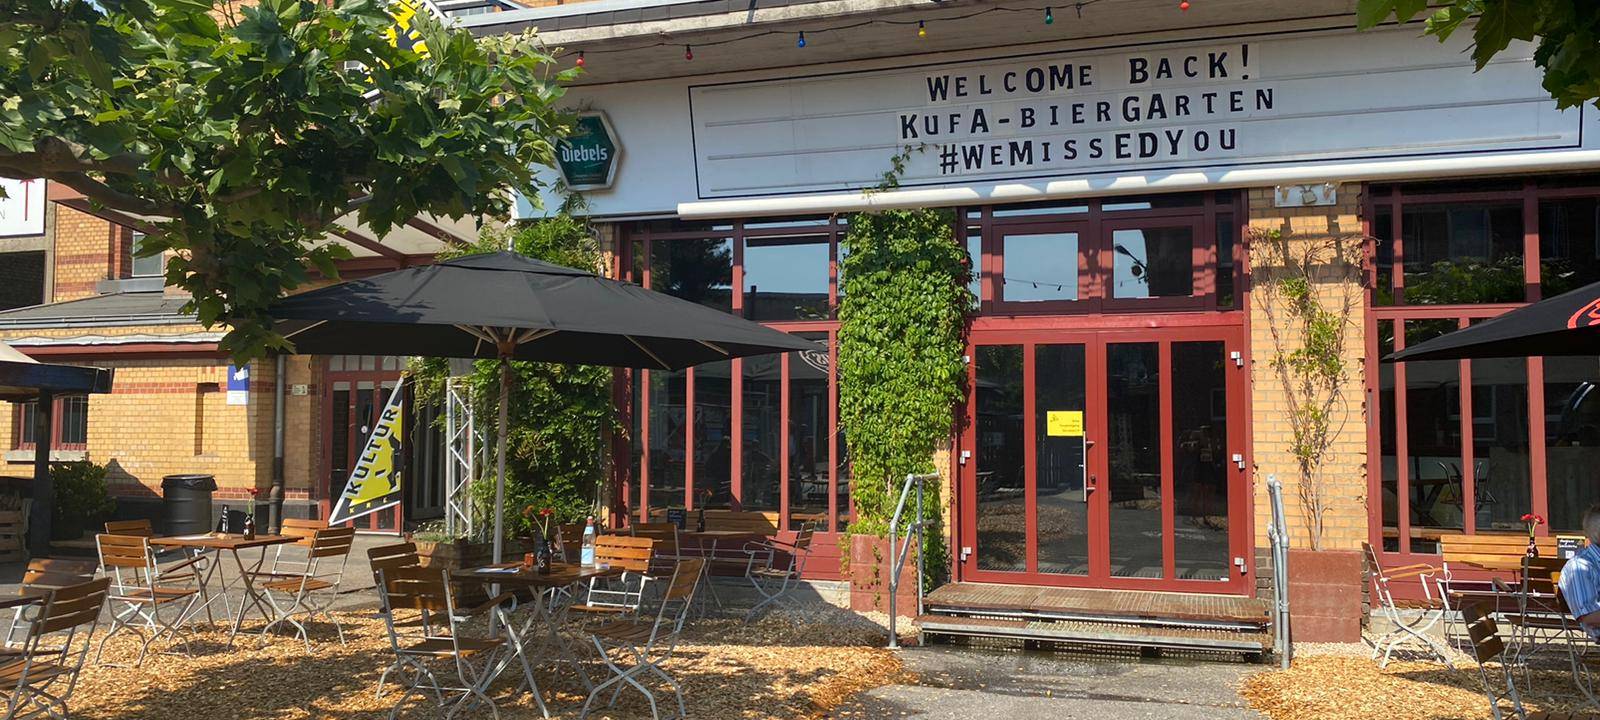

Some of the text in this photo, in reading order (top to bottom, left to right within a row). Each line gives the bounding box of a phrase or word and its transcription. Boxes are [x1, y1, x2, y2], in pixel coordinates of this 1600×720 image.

[926, 43, 1250, 102] WELCOME BACK!
[899, 87, 1274, 139] KUFA-BIERGARTEN
[560, 143, 608, 162] Diebels
[939, 127, 1237, 175] #WEMISSEDYOU
[345, 408, 399, 496] KULTUR
